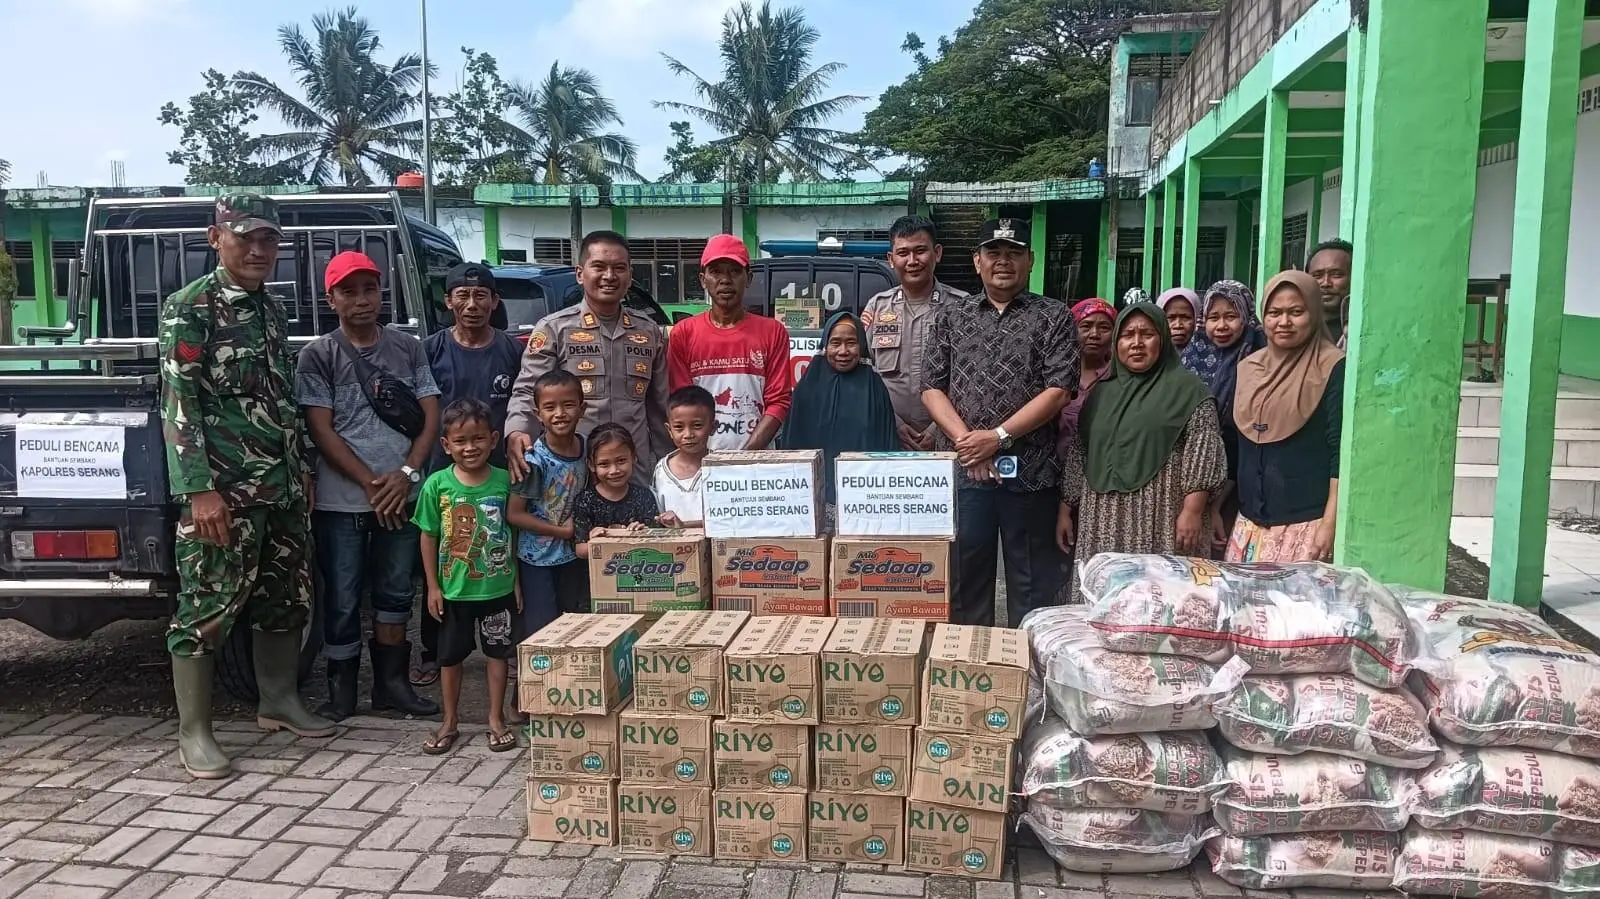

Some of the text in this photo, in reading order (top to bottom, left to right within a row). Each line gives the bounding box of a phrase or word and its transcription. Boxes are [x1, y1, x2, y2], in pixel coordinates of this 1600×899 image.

[569, 345, 600, 355] DESMA
[626, 346, 652, 357] POLRI
[709, 358, 731, 366] KAMU
[20, 439, 120, 453] PEDULI BENCANA
[20, 466, 121, 478] KAPOLRES SERANG
[706, 478, 809, 492] PEDULI BENCANA
[842, 476, 949, 488] PEDULI BENCANA
[709, 504, 809, 517] KAPOLRES SERANG
[843, 503, 948, 514] KAPOLRES SERANG
[603, 558, 686, 577] Sedaap
[726, 556, 809, 575] Sedaap
[847, 559, 935, 578] Sedaap
[763, 601, 823, 613] Ayam Bawang
[886, 604, 947, 615] Ayam Bawang
